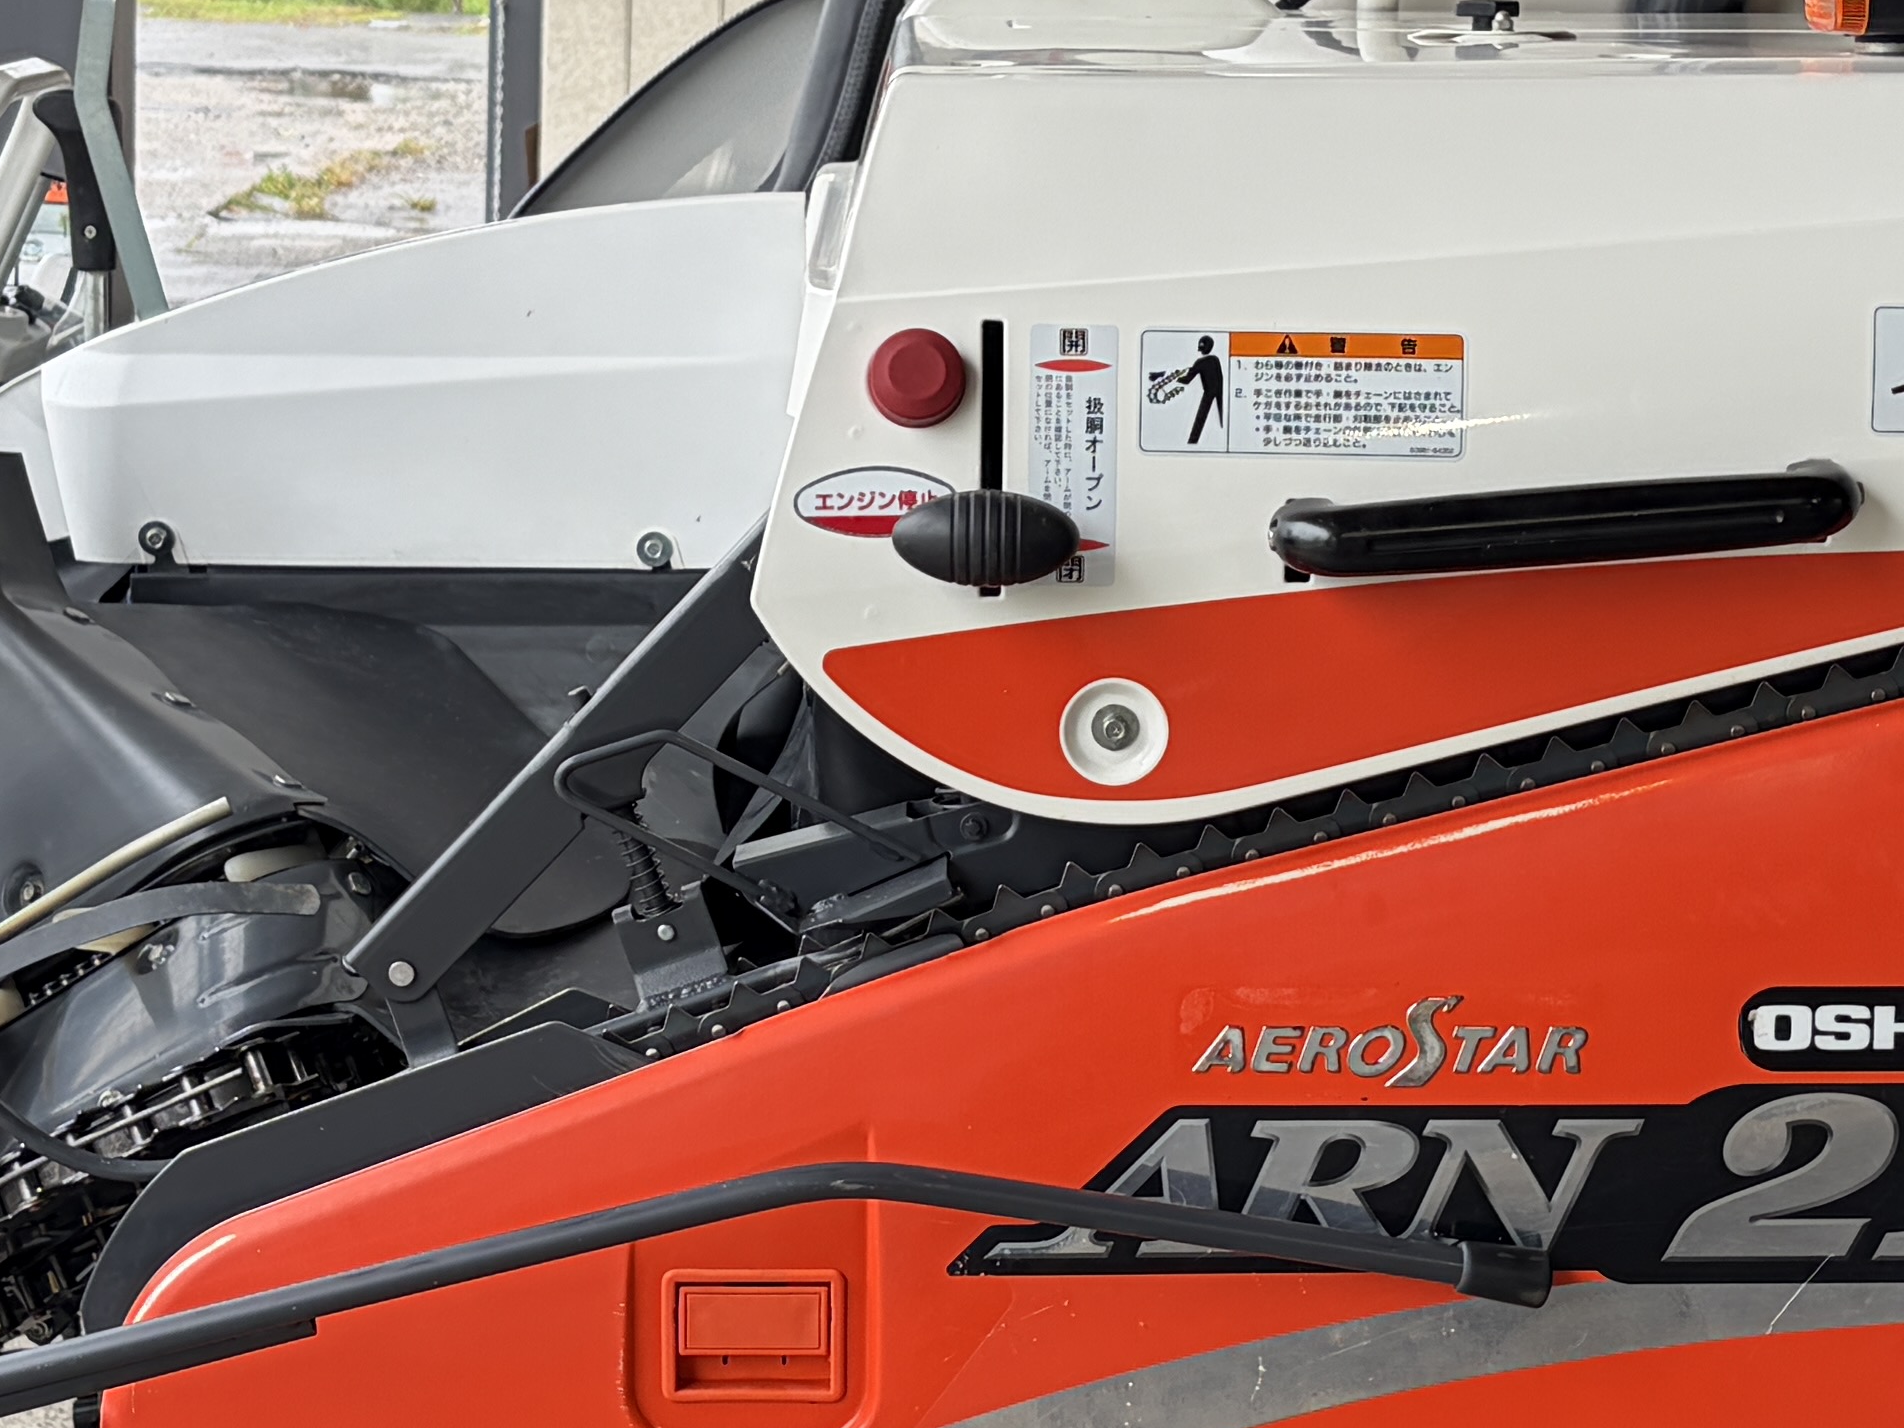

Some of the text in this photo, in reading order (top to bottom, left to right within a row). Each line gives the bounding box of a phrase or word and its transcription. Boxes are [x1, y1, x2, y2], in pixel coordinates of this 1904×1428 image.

[1060, 329, 1088, 356] 開
[1084, 397, 1105, 512] 扱胴オープン
[1192, 994, 1589, 1088] AEROSTAR
[984, 1117, 1645, 1261] ARN
